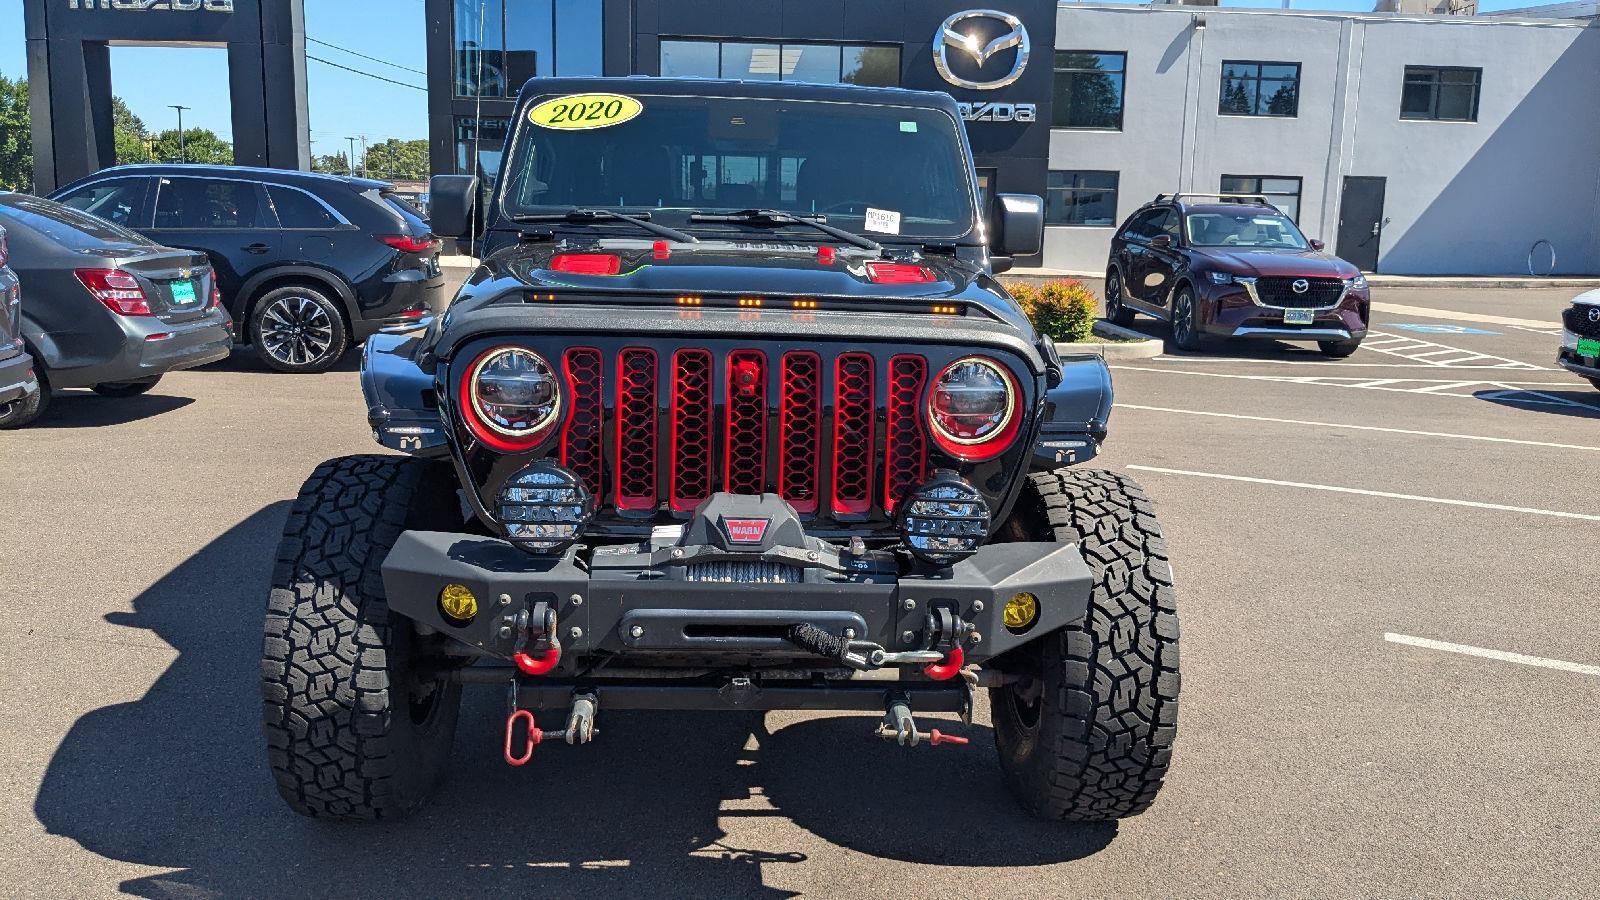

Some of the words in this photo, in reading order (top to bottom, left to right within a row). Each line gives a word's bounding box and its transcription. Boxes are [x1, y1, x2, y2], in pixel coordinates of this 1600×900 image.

[548, 99, 623, 124] 2020
[957, 102, 1036, 122] azda
[732, 526, 761, 535] WARN
